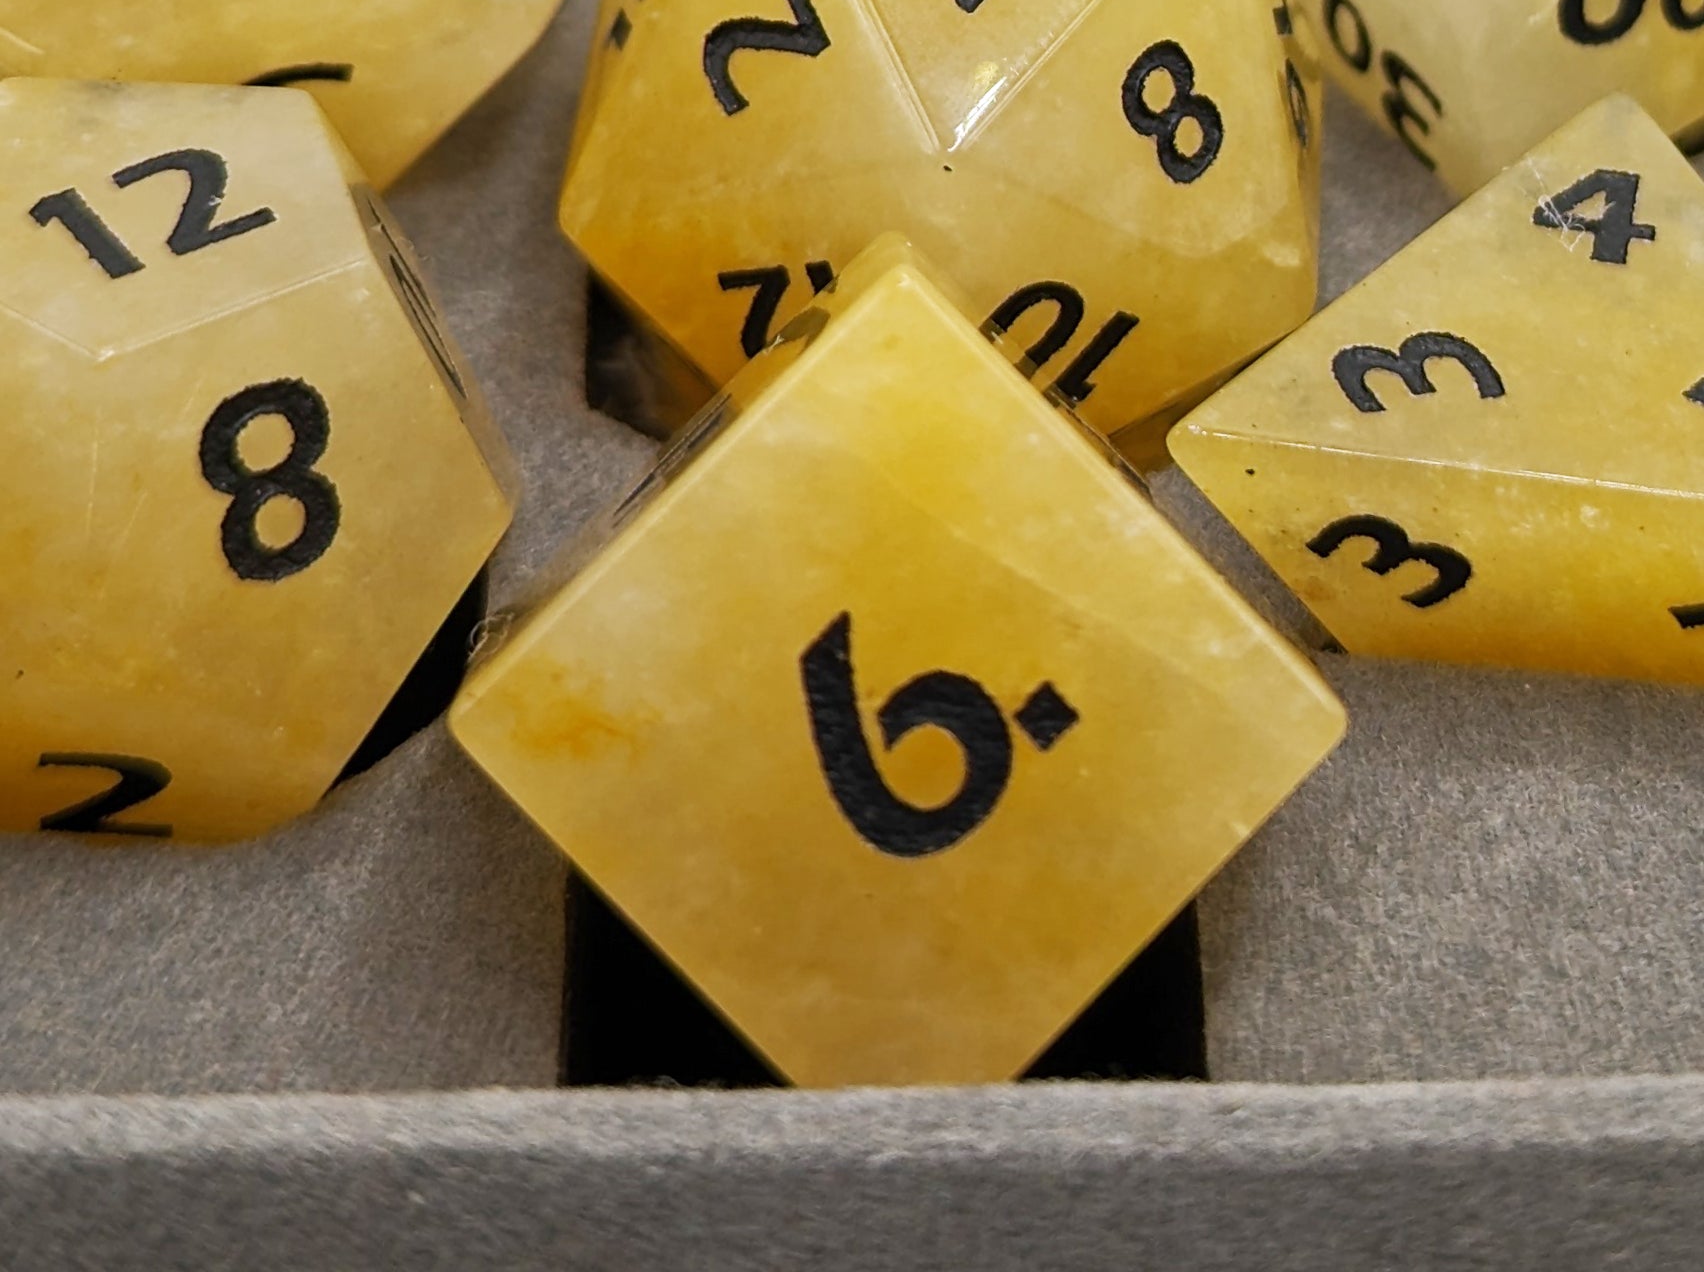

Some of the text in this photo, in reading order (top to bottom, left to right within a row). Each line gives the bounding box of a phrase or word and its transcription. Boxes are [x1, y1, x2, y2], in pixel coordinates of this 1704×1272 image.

[1121, 40, 1224, 184] 8
[28, 147, 278, 280] 12
[1533, 168, 1657, 265] 4
[1331, 331, 1506, 414] 3
[200, 377, 342, 582] 8
[1305, 513, 1473, 609] 3
[37, 751, 173, 838] 2
